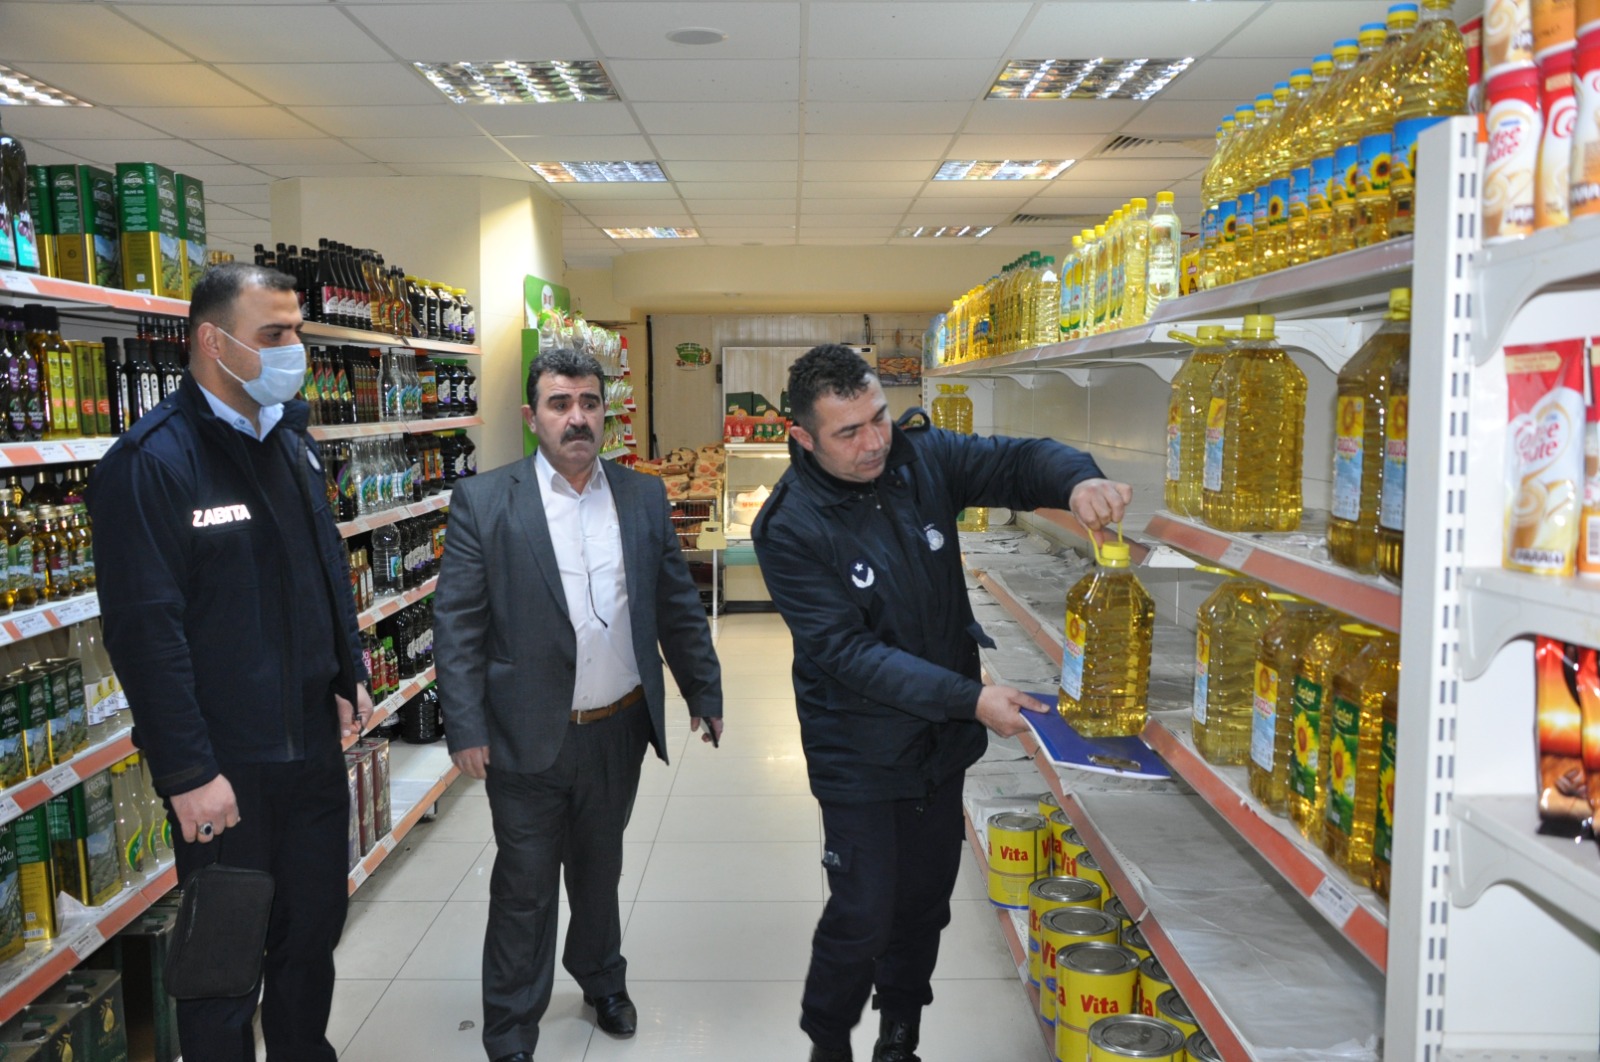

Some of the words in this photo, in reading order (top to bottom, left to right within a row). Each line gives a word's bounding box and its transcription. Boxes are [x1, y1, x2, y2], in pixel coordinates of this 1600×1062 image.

[192, 504, 252, 527] ZABITA
[1000, 845, 1029, 861] Vita
[1042, 939, 1057, 969] Vi
[1081, 994, 1119, 1014] Vita
